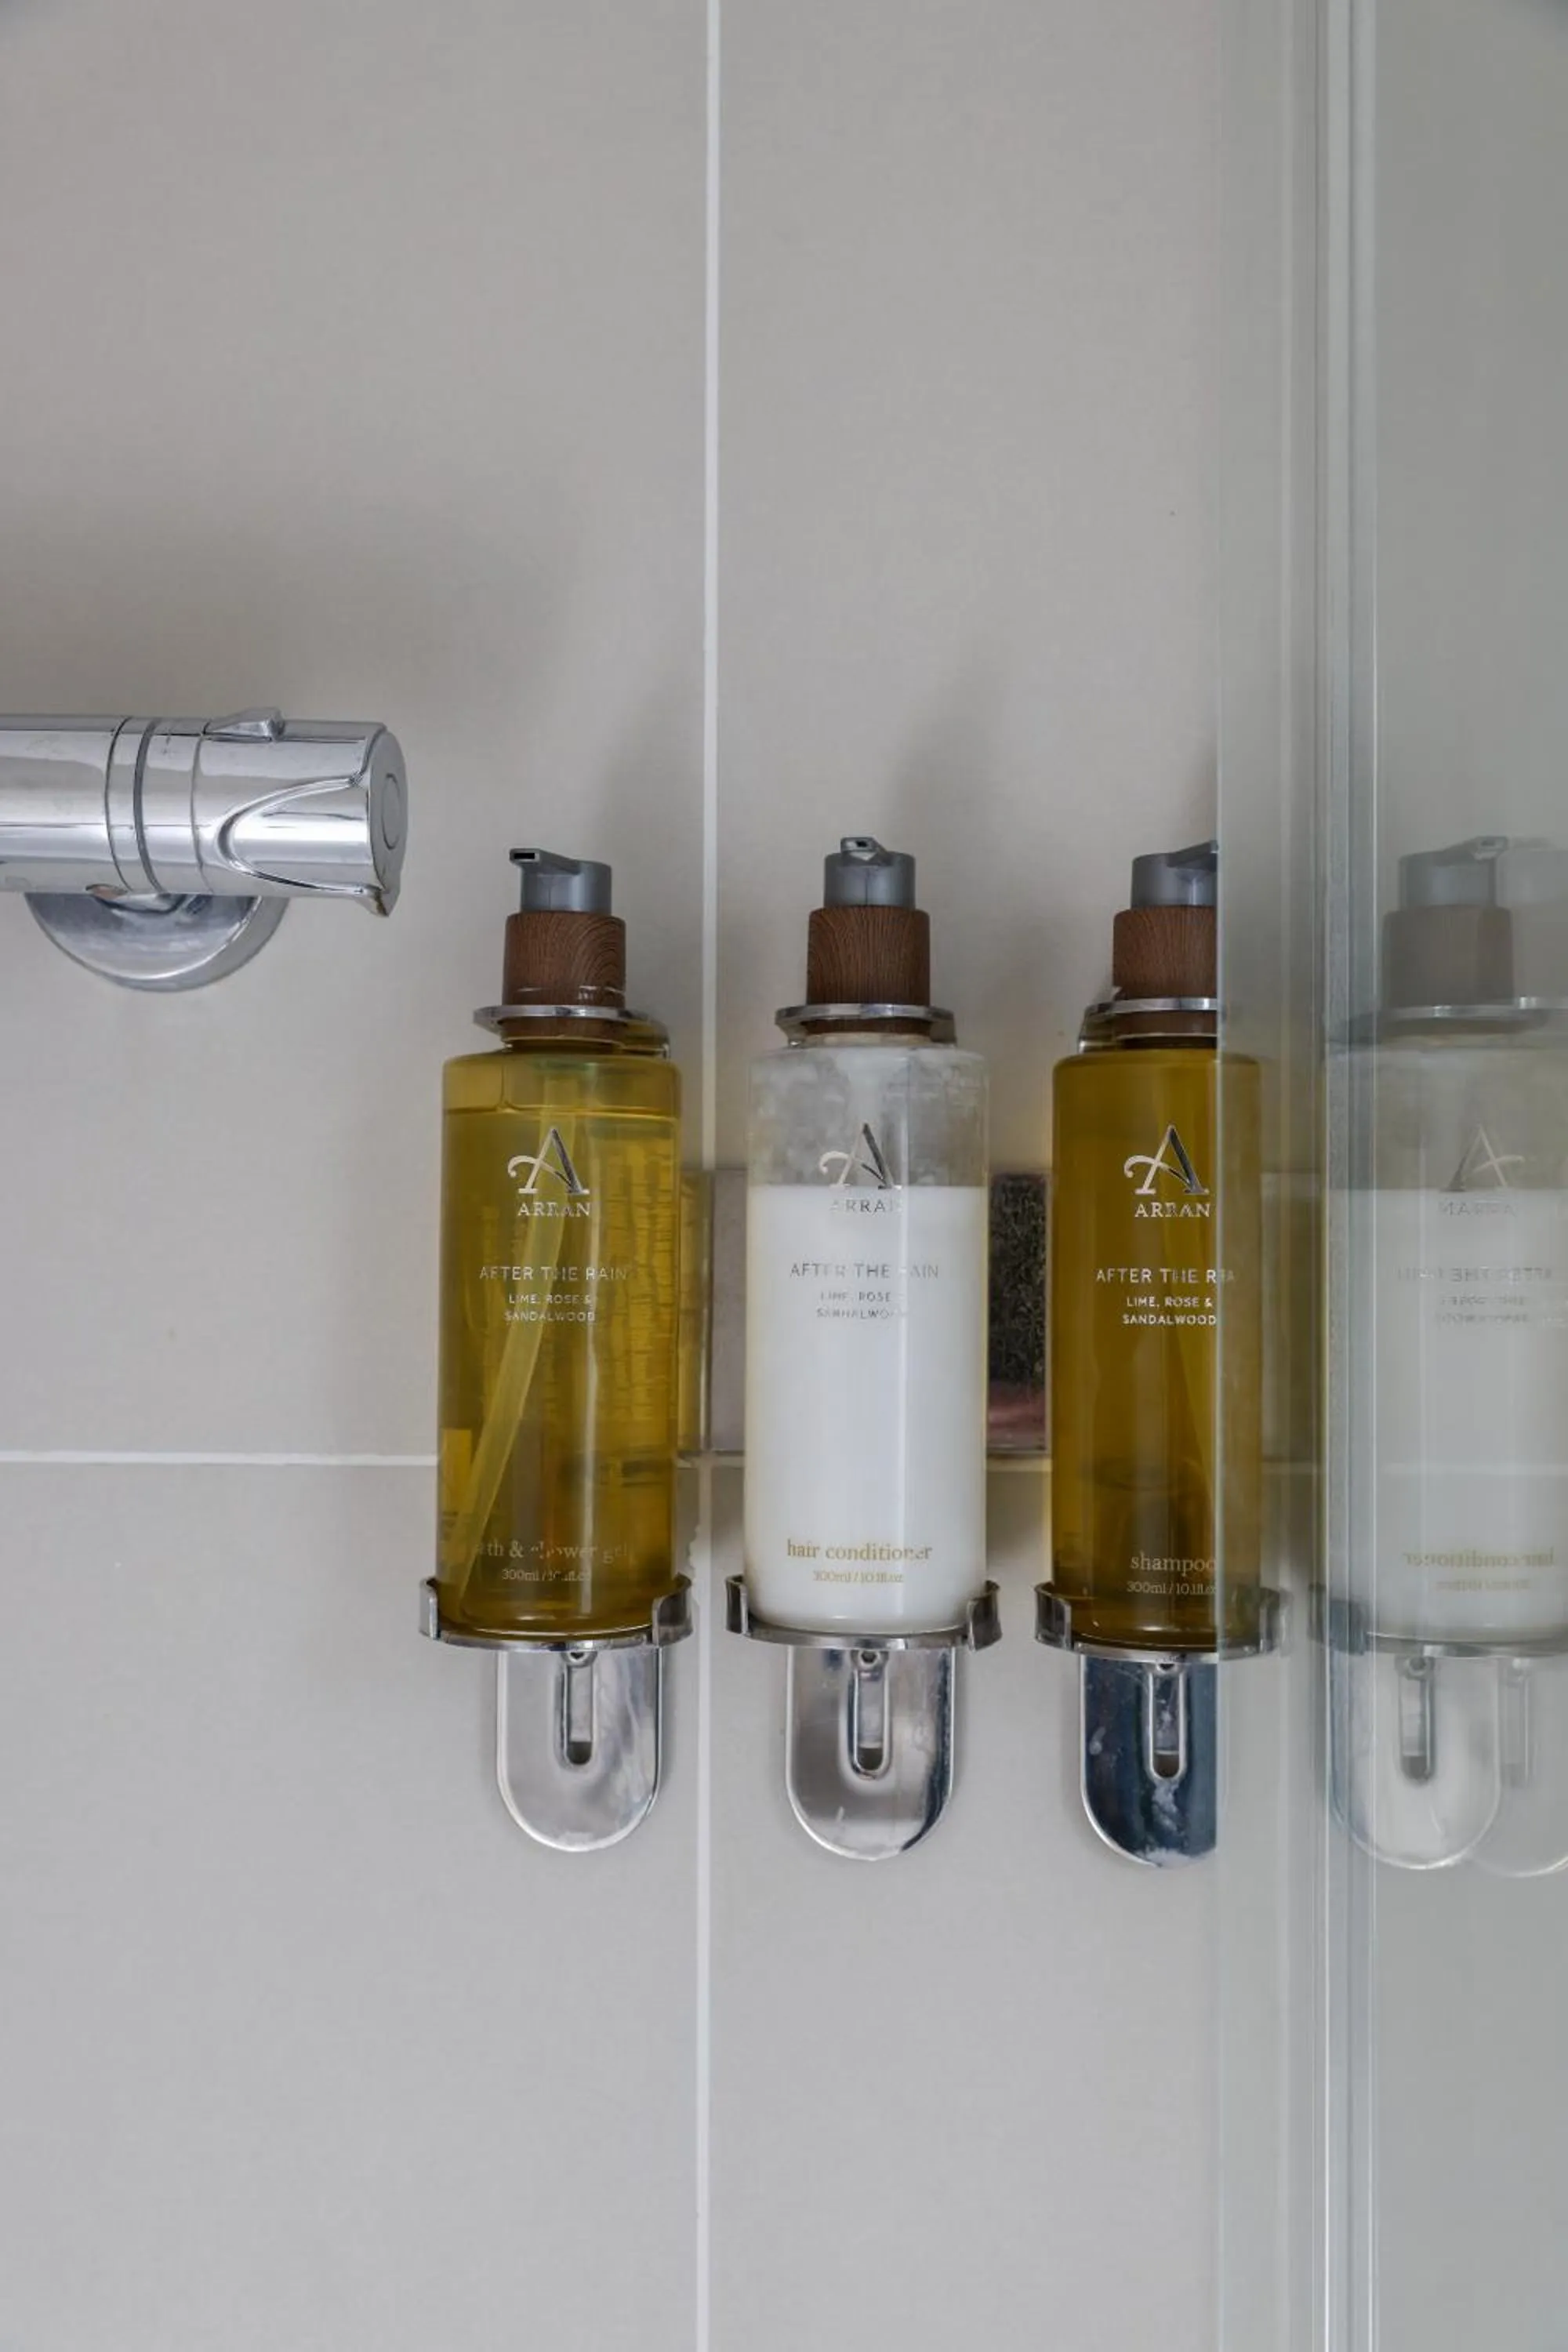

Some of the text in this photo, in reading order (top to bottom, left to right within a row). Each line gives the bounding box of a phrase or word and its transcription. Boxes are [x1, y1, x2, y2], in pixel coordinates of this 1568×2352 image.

[1134, 1201, 1211, 1218] ARRAN
[854, 1263, 891, 1279] THE
[1096, 1268, 1152, 1284] AFTER
[1159, 1268, 1199, 1284] THE
[1127, 1296, 1214, 1308] LIME, ROSE &
[1122, 1313, 1218, 1325] SANDALWOOD
[509, 1539, 524, 1558] &
[786, 1539, 821, 1559] hair
